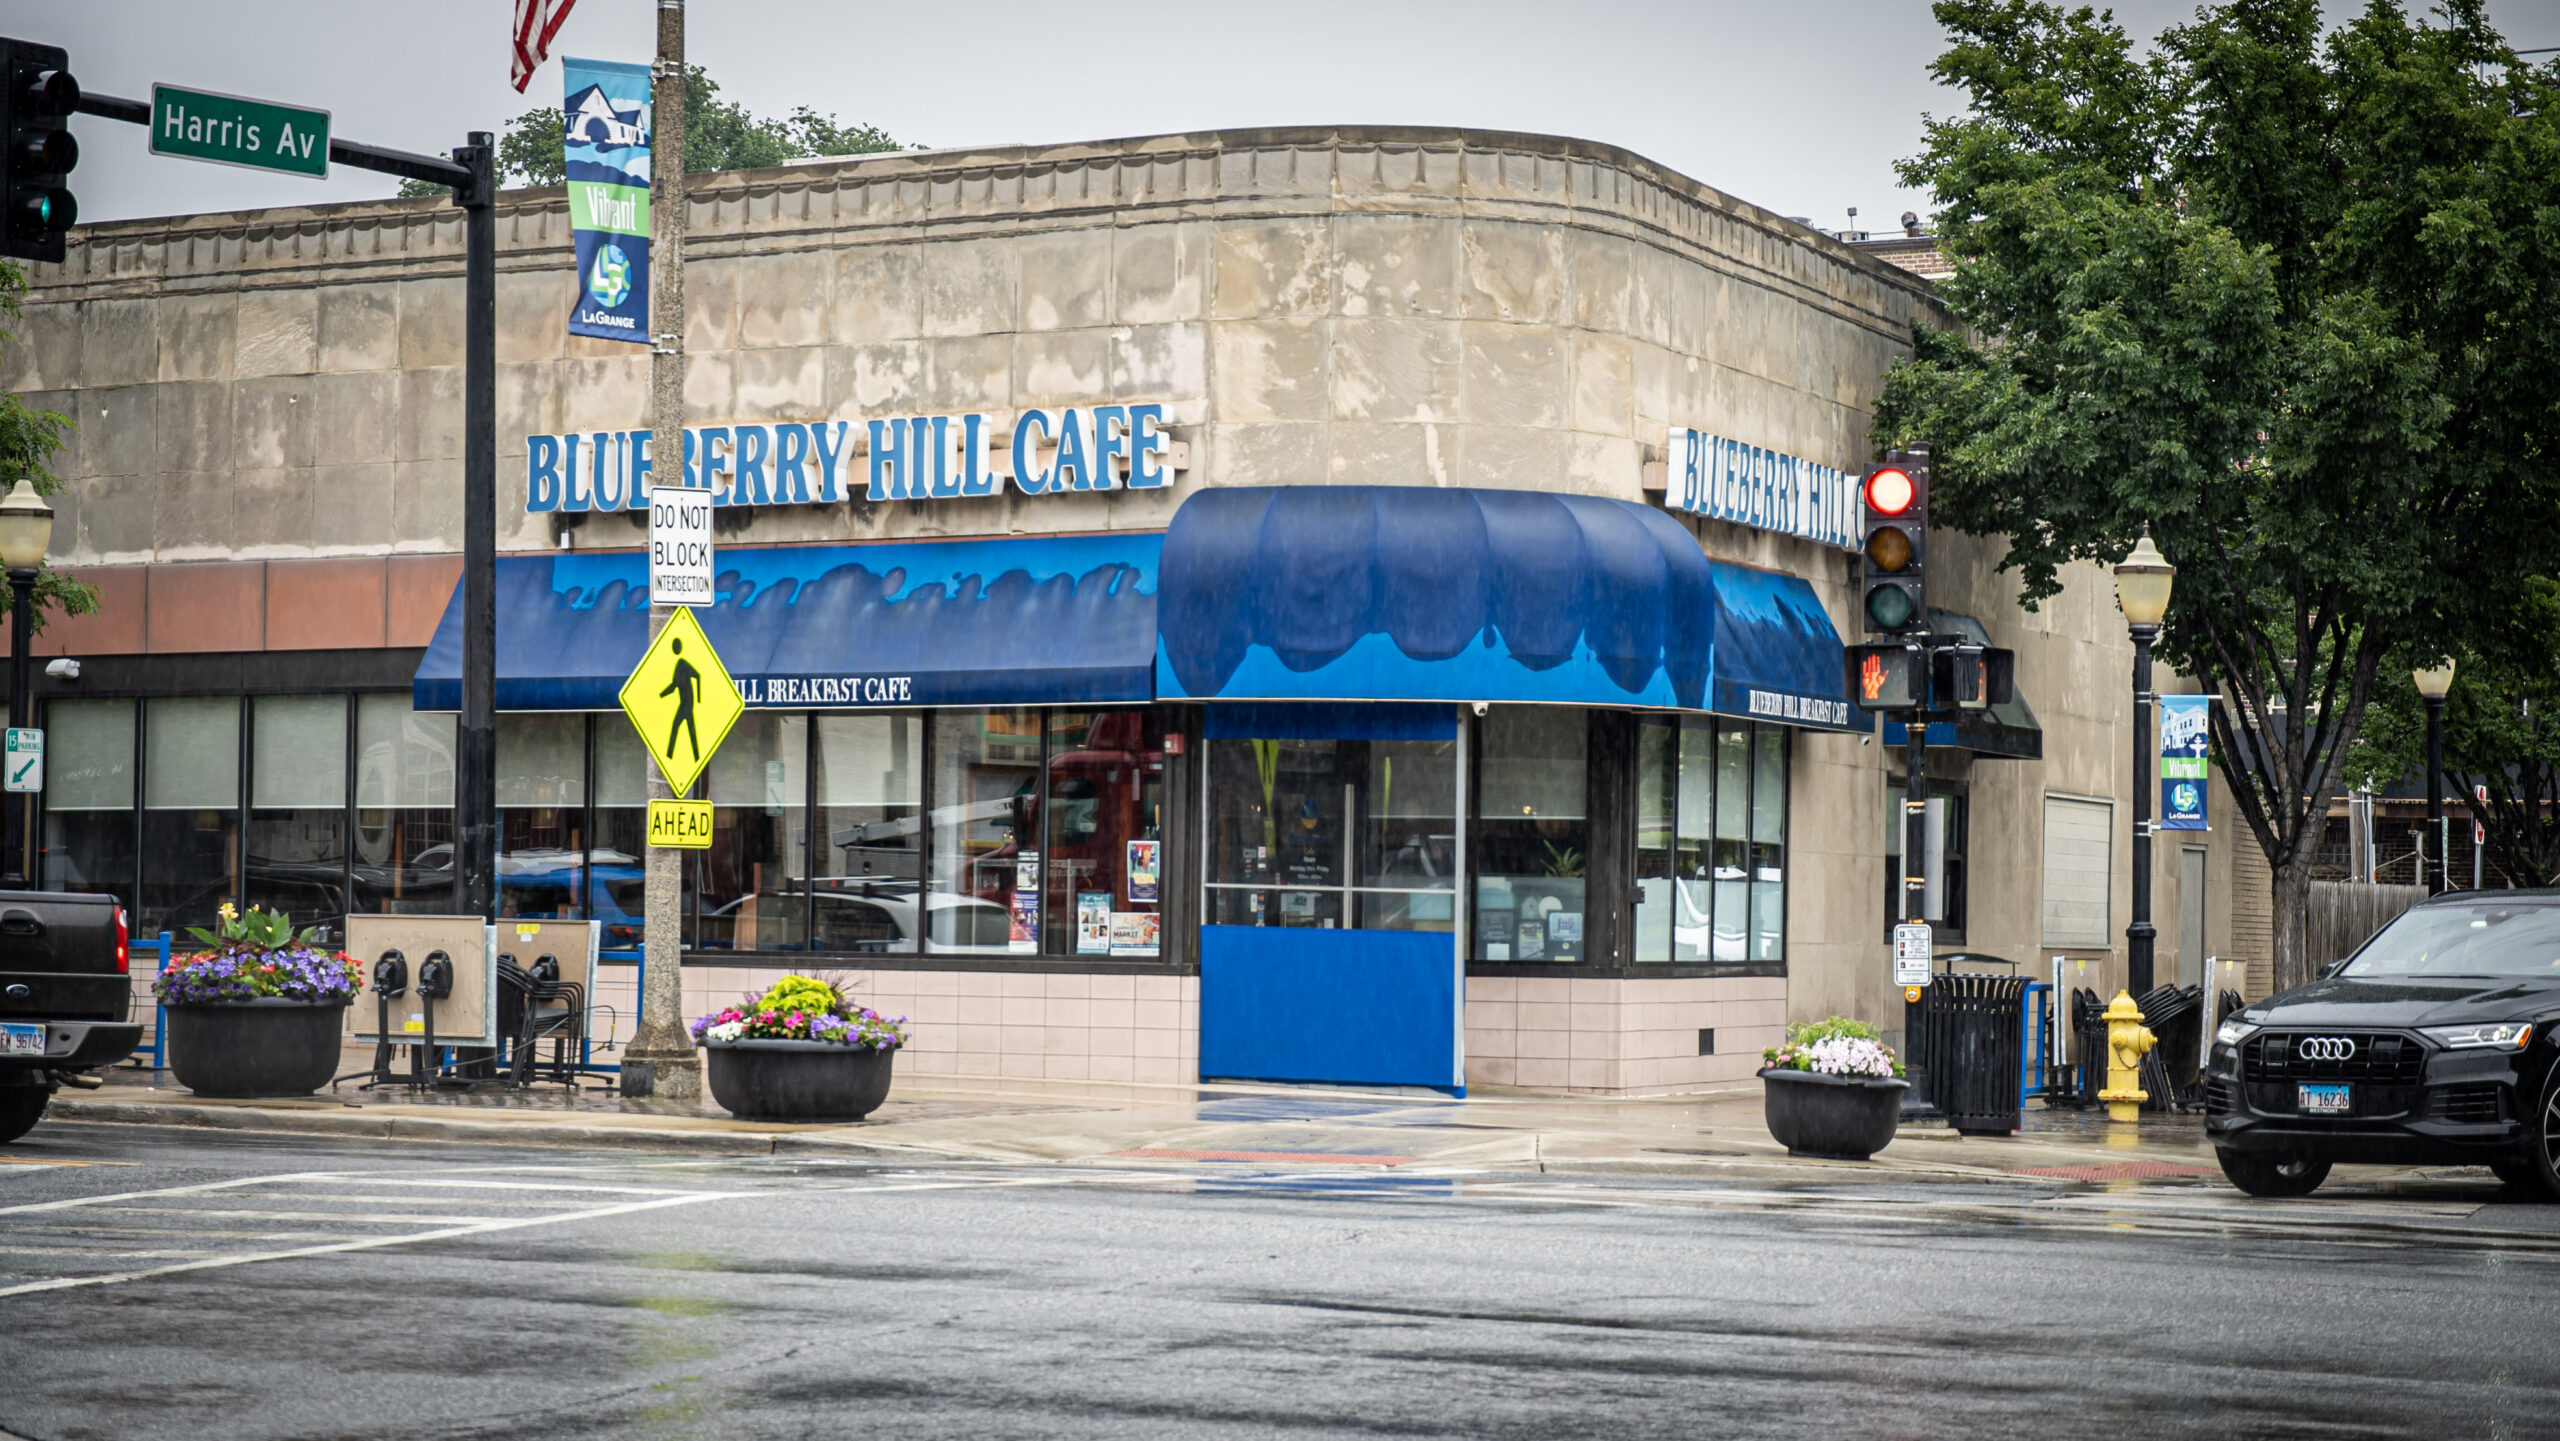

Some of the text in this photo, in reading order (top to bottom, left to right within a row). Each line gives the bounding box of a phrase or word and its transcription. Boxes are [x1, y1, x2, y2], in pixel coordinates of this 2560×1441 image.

[165, 103, 316, 160] Harris Av
[586, 186, 637, 232] Vibrant
[867, 413, 1000, 501] HILL
[1011, 403, 1171, 495] CAFE
[1683, 428, 1804, 535] BLUEBERRY
[1808, 460, 1849, 548] HILL
[655, 504, 708, 530] DO NOT
[655, 541, 708, 567] BLOCK
[655, 575, 710, 592] INTERSECTION
[732, 677, 912, 702] ILL BREAKFAST CAFE
[1784, 694, 1799, 718] HILL
[1799, 697, 1832, 722] BREAKFAST
[1832, 702, 1849, 725] CAFE
[8, 735, 17, 747] 15
[18, 742, 41, 750] PARKING
[2169, 758, 2201, 777] Vibrant
[652, 811, 710, 837] AHEAD
[16, 1033, 44, 1050] 96742
[2300, 1092, 2348, 1107] AT 16236
